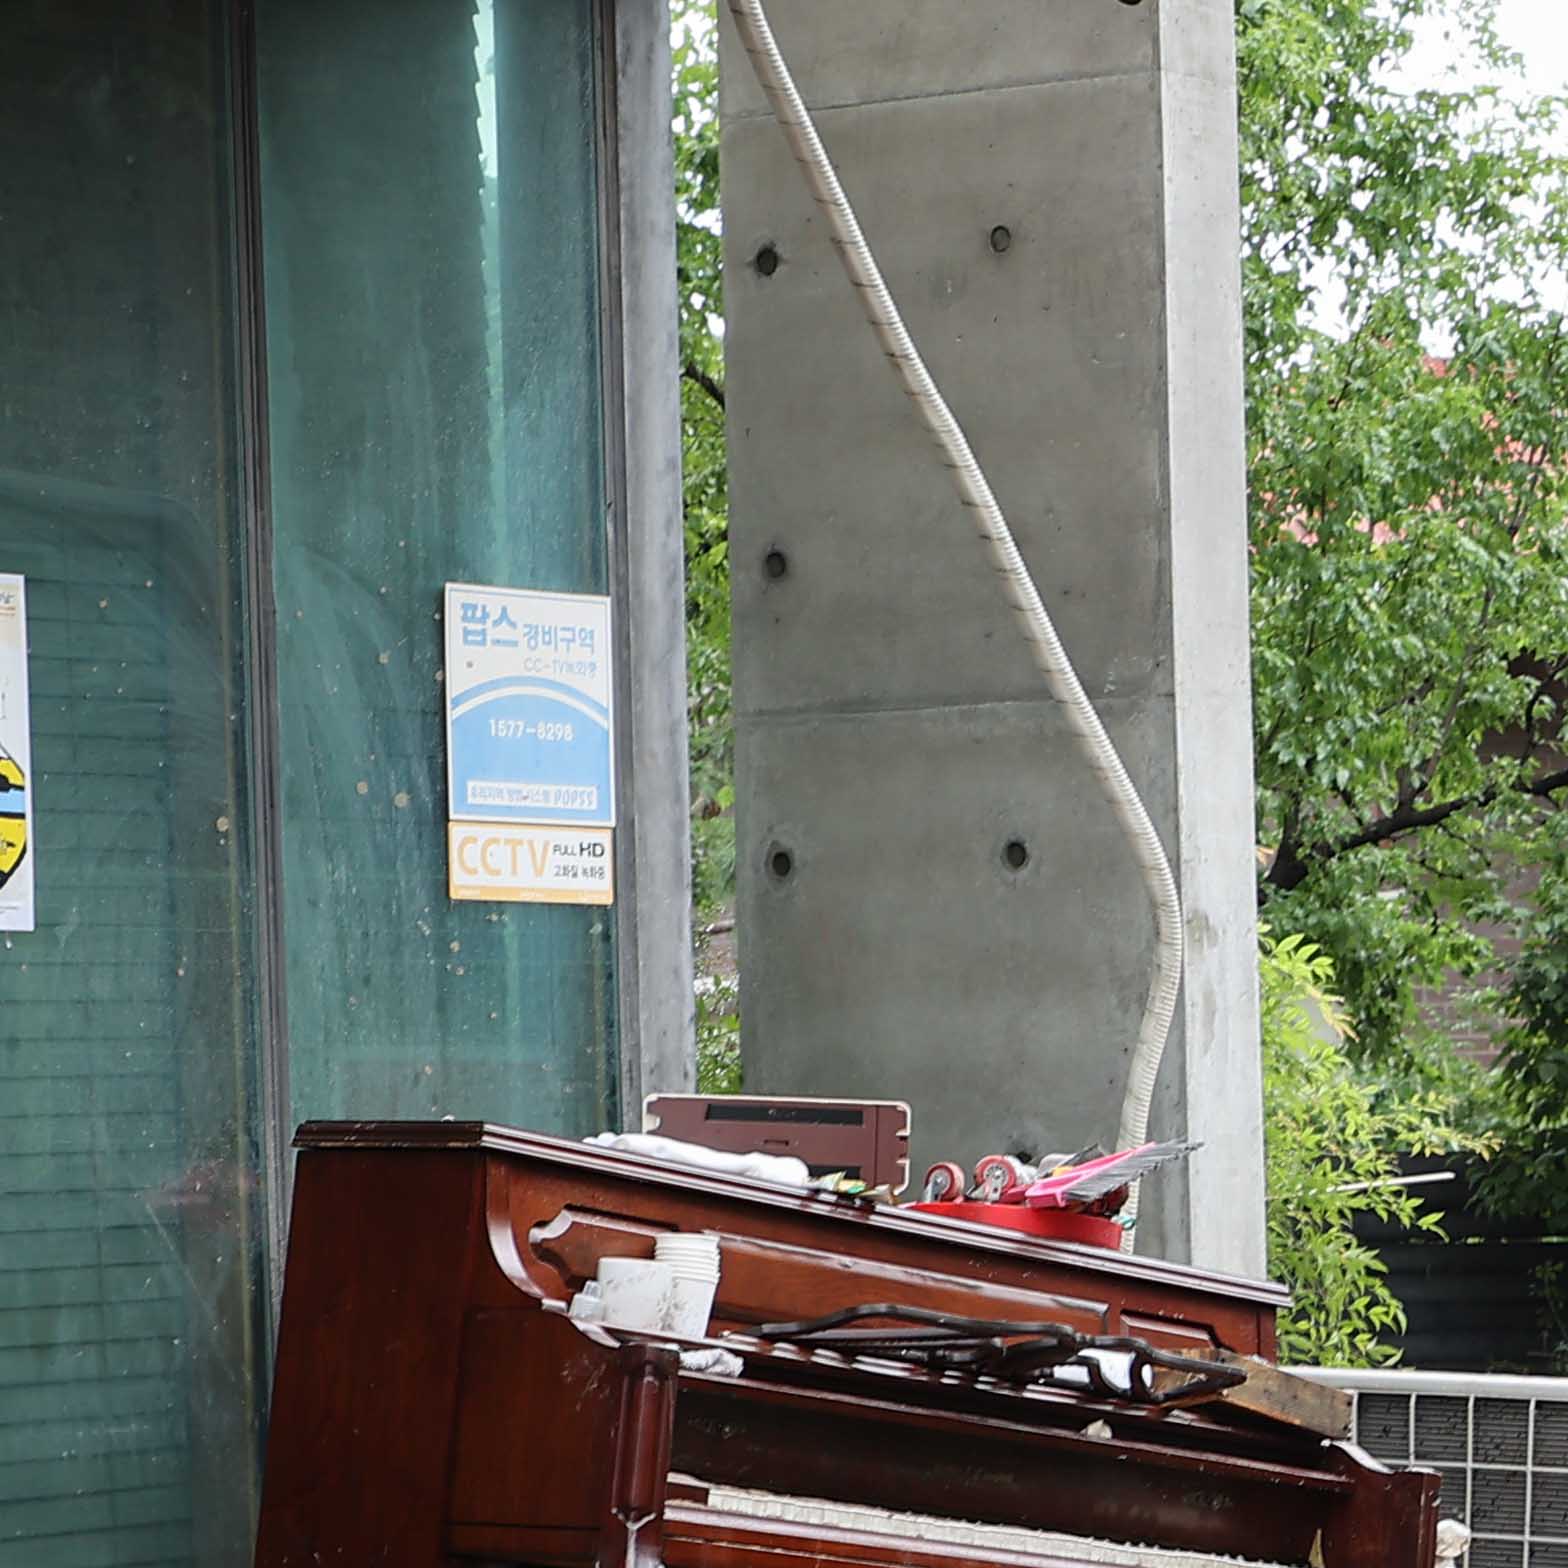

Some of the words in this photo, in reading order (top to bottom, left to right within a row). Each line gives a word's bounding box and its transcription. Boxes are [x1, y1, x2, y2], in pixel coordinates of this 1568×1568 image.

[460, 601, 519, 648] 팝스
[523, 623, 594, 654] 경비구역
[457, 834, 549, 878] CCTV
[552, 844, 577, 857] FULL
[578, 841, 605, 858] HD
